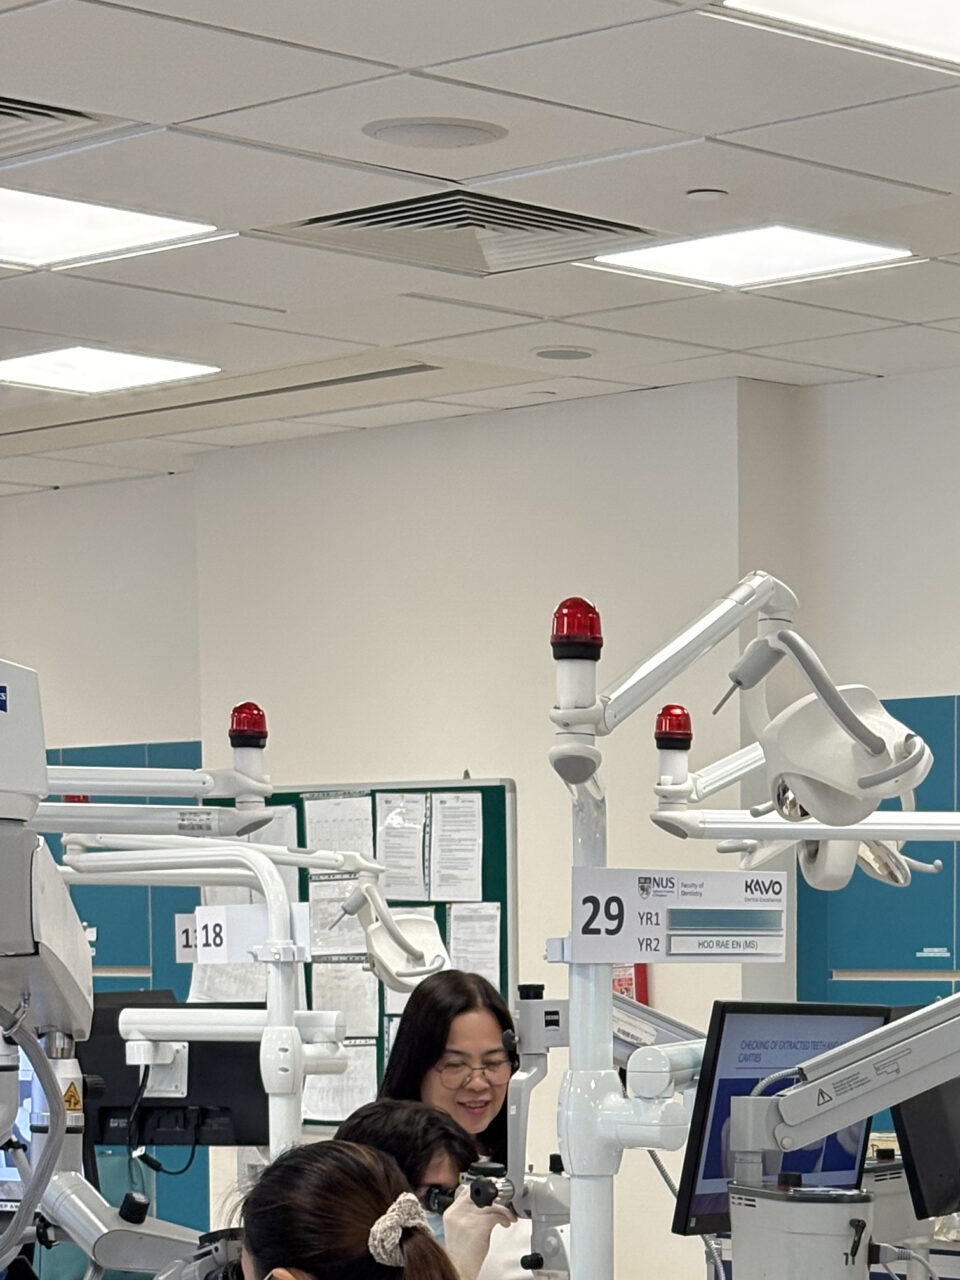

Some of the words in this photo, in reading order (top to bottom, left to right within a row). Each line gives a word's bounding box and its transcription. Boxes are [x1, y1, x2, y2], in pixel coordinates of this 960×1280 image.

[652, 876, 675, 889] NUS
[681, 881, 699, 890] Faculty
[681, 889, 703, 897] Dentistry
[581, 895, 625, 936] 29
[637, 911, 660, 926] YR1
[201, 922, 223, 948] 18
[637, 938, 660, 952] YR2
[697, 941, 715, 950] HOO
[715, 941, 731, 950] RAE
[731, 942, 742, 950] EN
[742, 941, 758, 951] (MS)
